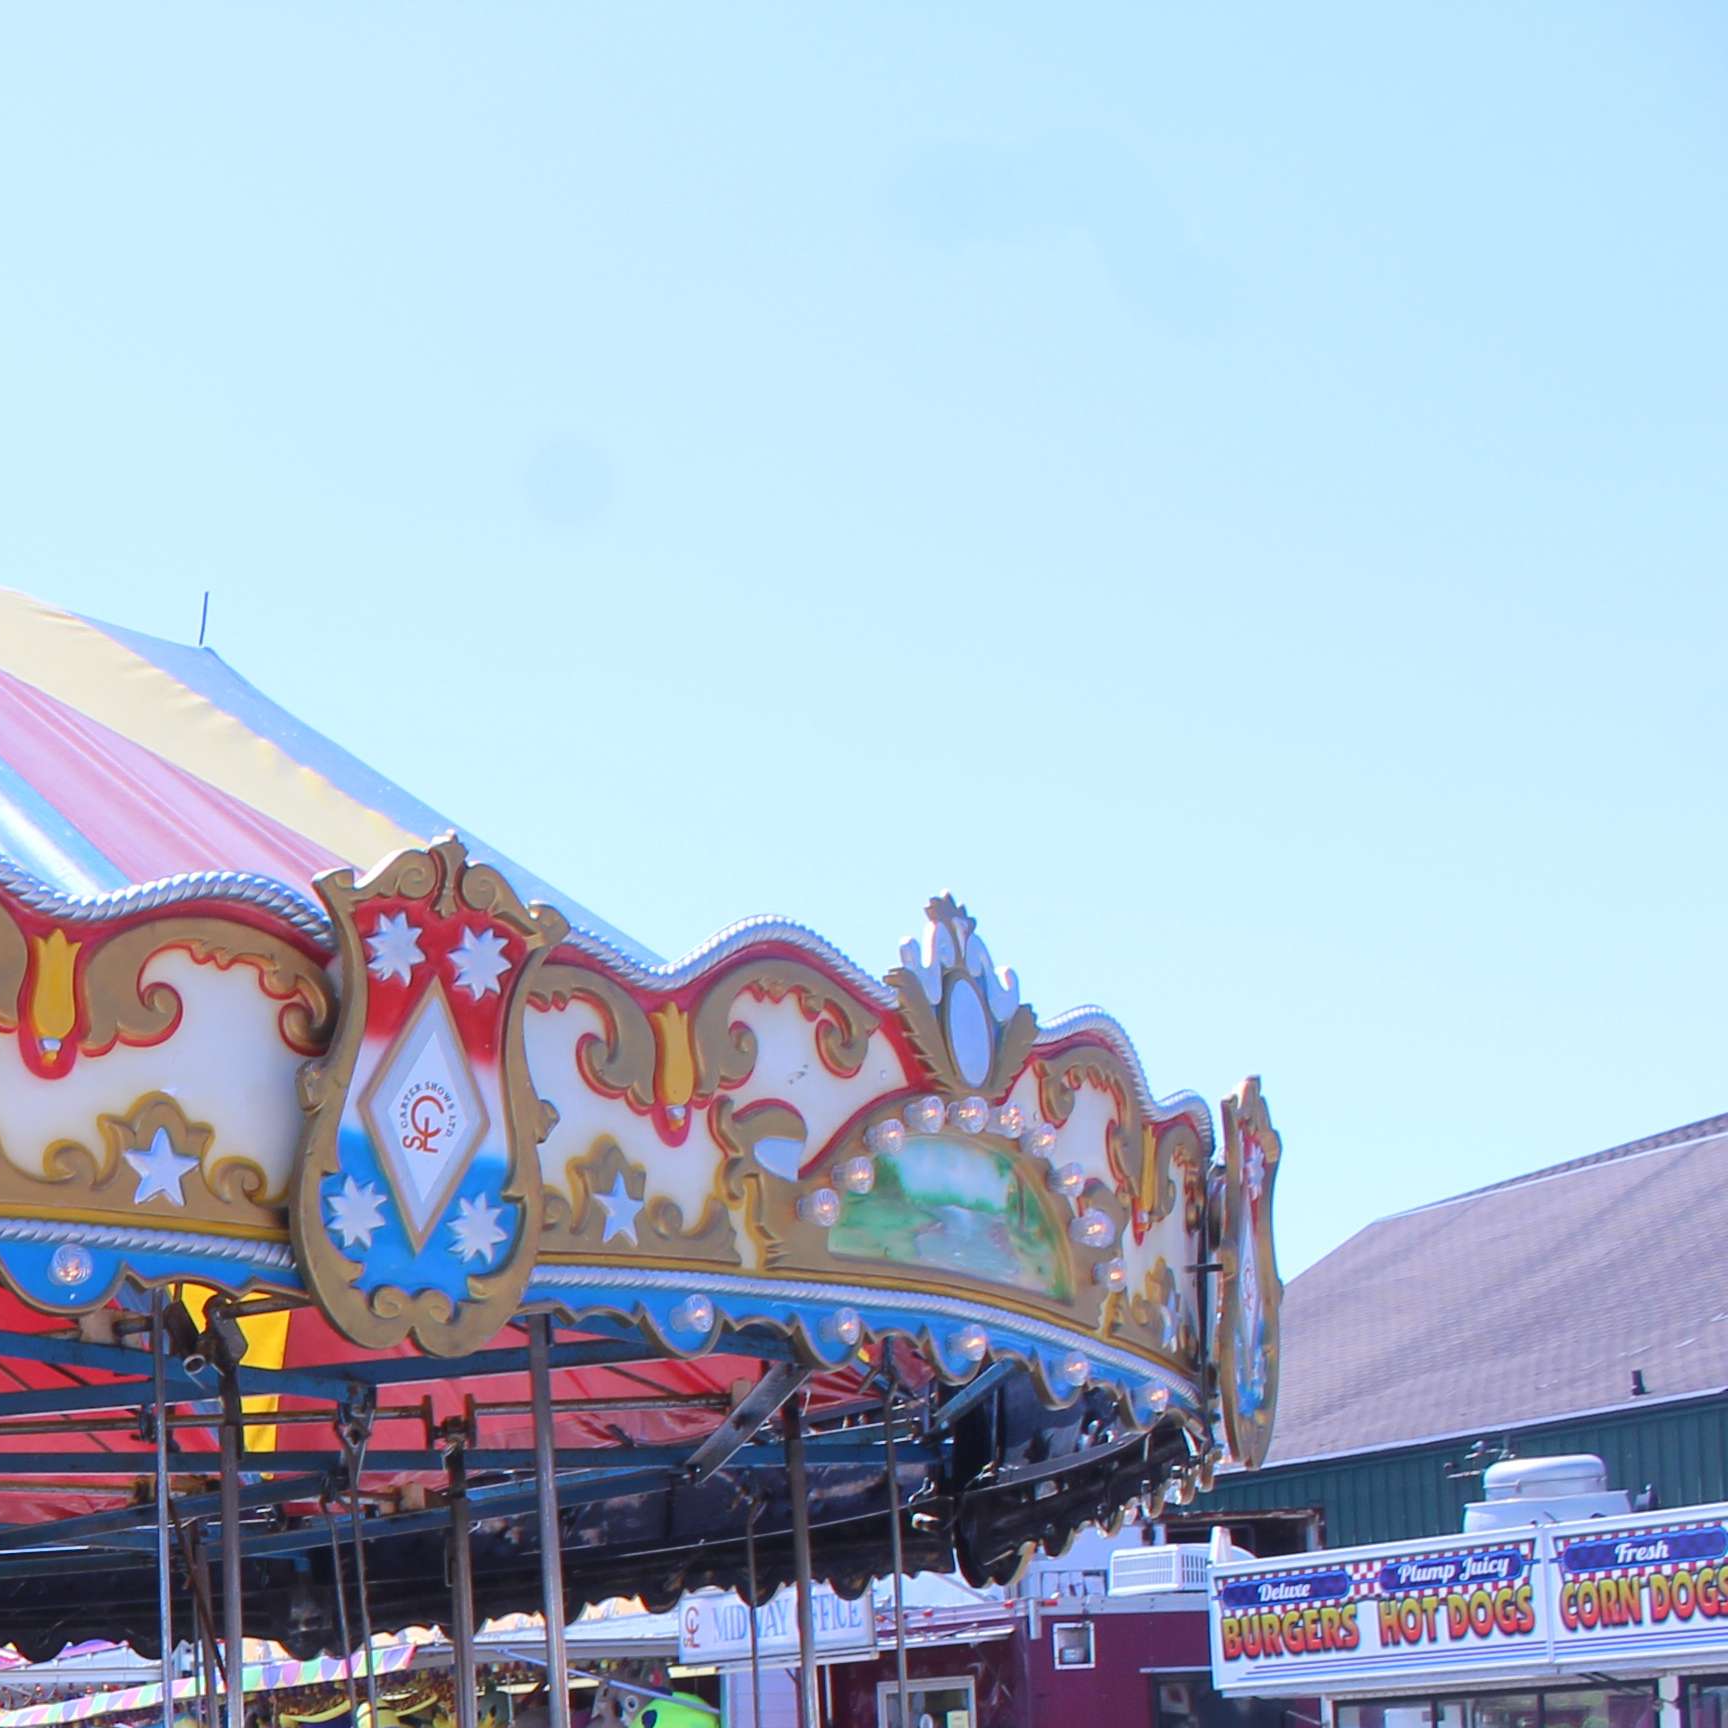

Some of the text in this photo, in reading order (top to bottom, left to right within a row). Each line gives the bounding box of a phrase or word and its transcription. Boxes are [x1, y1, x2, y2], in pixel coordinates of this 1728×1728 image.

[1397, 1553, 1510, 1584] Plump Juicy
[1615, 1543, 1669, 1563] Fresh
[1257, 1582, 1311, 1602] Deluxe
[1560, 1575, 1642, 1631] CORN
[712, 1599, 790, 1642] MIDAY
[1222, 1603, 1360, 1661] BURGERS
[1378, 1583, 1535, 1647] HOT DOGS
